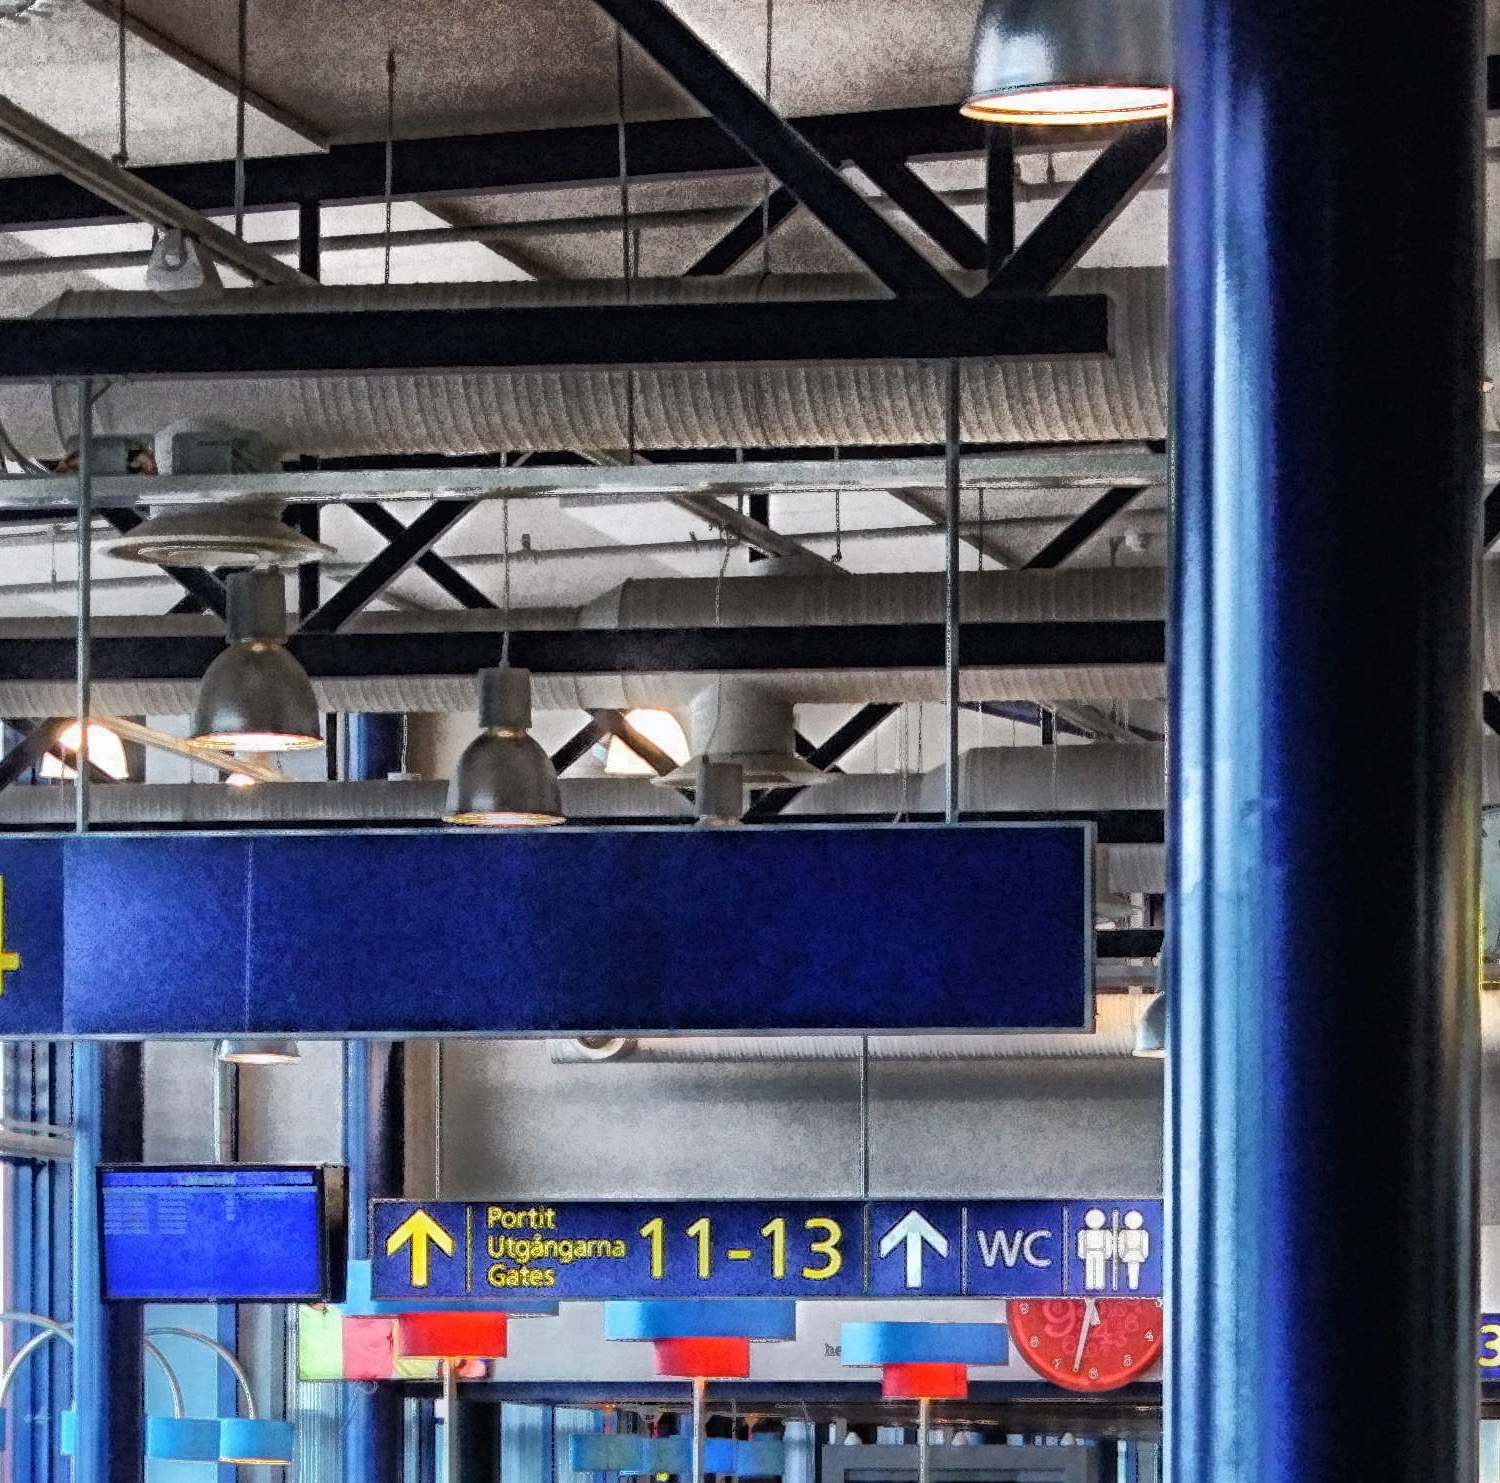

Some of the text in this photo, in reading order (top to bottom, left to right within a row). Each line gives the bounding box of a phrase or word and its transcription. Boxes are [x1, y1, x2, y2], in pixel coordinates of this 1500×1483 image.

[487, 1206, 556, 1230] Portit
[487, 1232, 627, 1264] Utgångarna
[638, 1217, 843, 1280] 11-13
[976, 1229, 1052, 1268] WC
[487, 1263, 556, 1287] Gates
